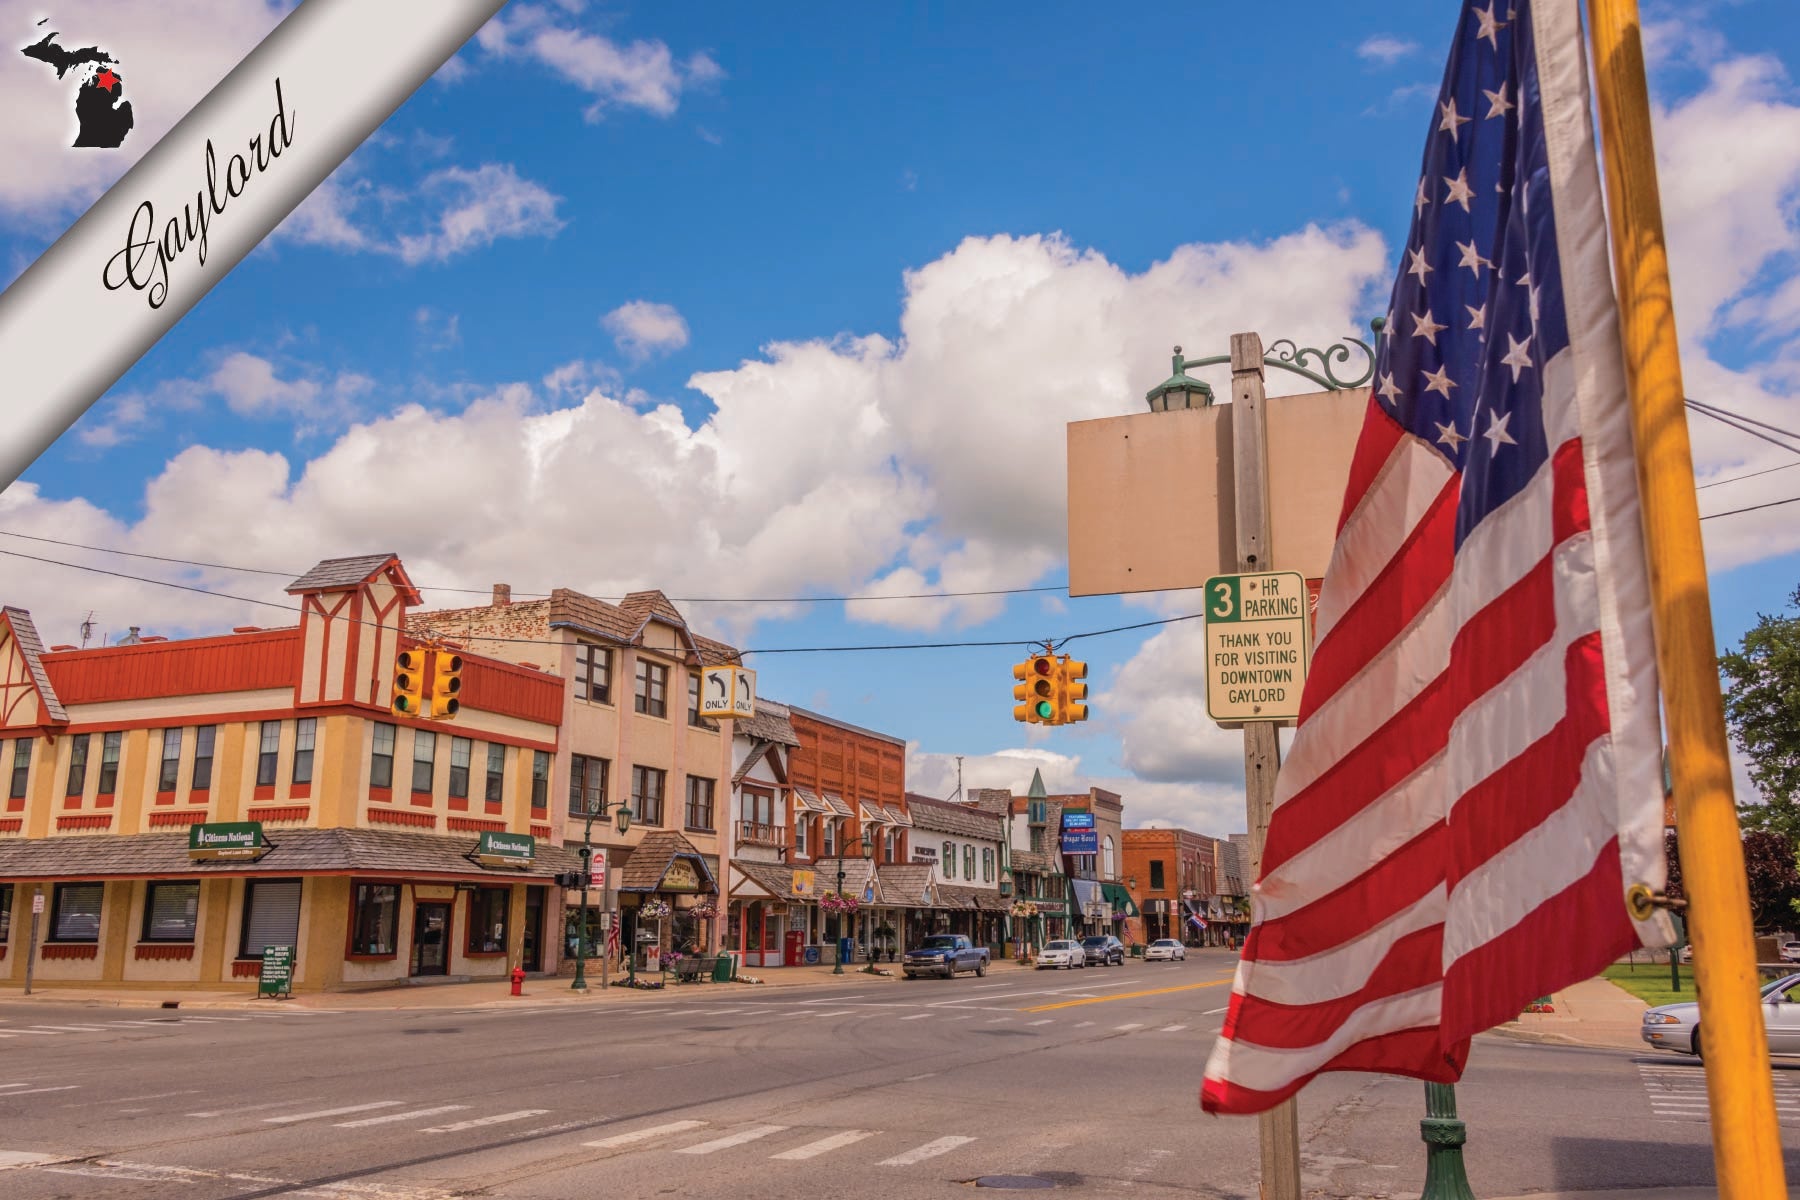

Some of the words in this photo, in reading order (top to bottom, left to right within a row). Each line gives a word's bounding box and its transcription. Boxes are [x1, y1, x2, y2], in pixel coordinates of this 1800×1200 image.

[1262, 579, 1279, 596] HR
[1213, 582, 1234, 618] 3
[1245, 597, 1298, 617] PARKING
[1219, 633, 1260, 648] THANK
[1266, 632, 1292, 646] YOU
[1215, 653, 1239, 667] FOR
[1245, 650, 1297, 665] VISITING
[1221, 669, 1292, 685] DOWNTOWN
[1229, 688, 1285, 704] GAYLORD
[705, 699, 729, 710] ONLY
[735, 700, 752, 711] ONLY
[205, 833, 228, 843] Citizens
[228, 831, 254, 842] National
[493, 841, 511, 850] Citizens
[511, 842, 530, 852] National
